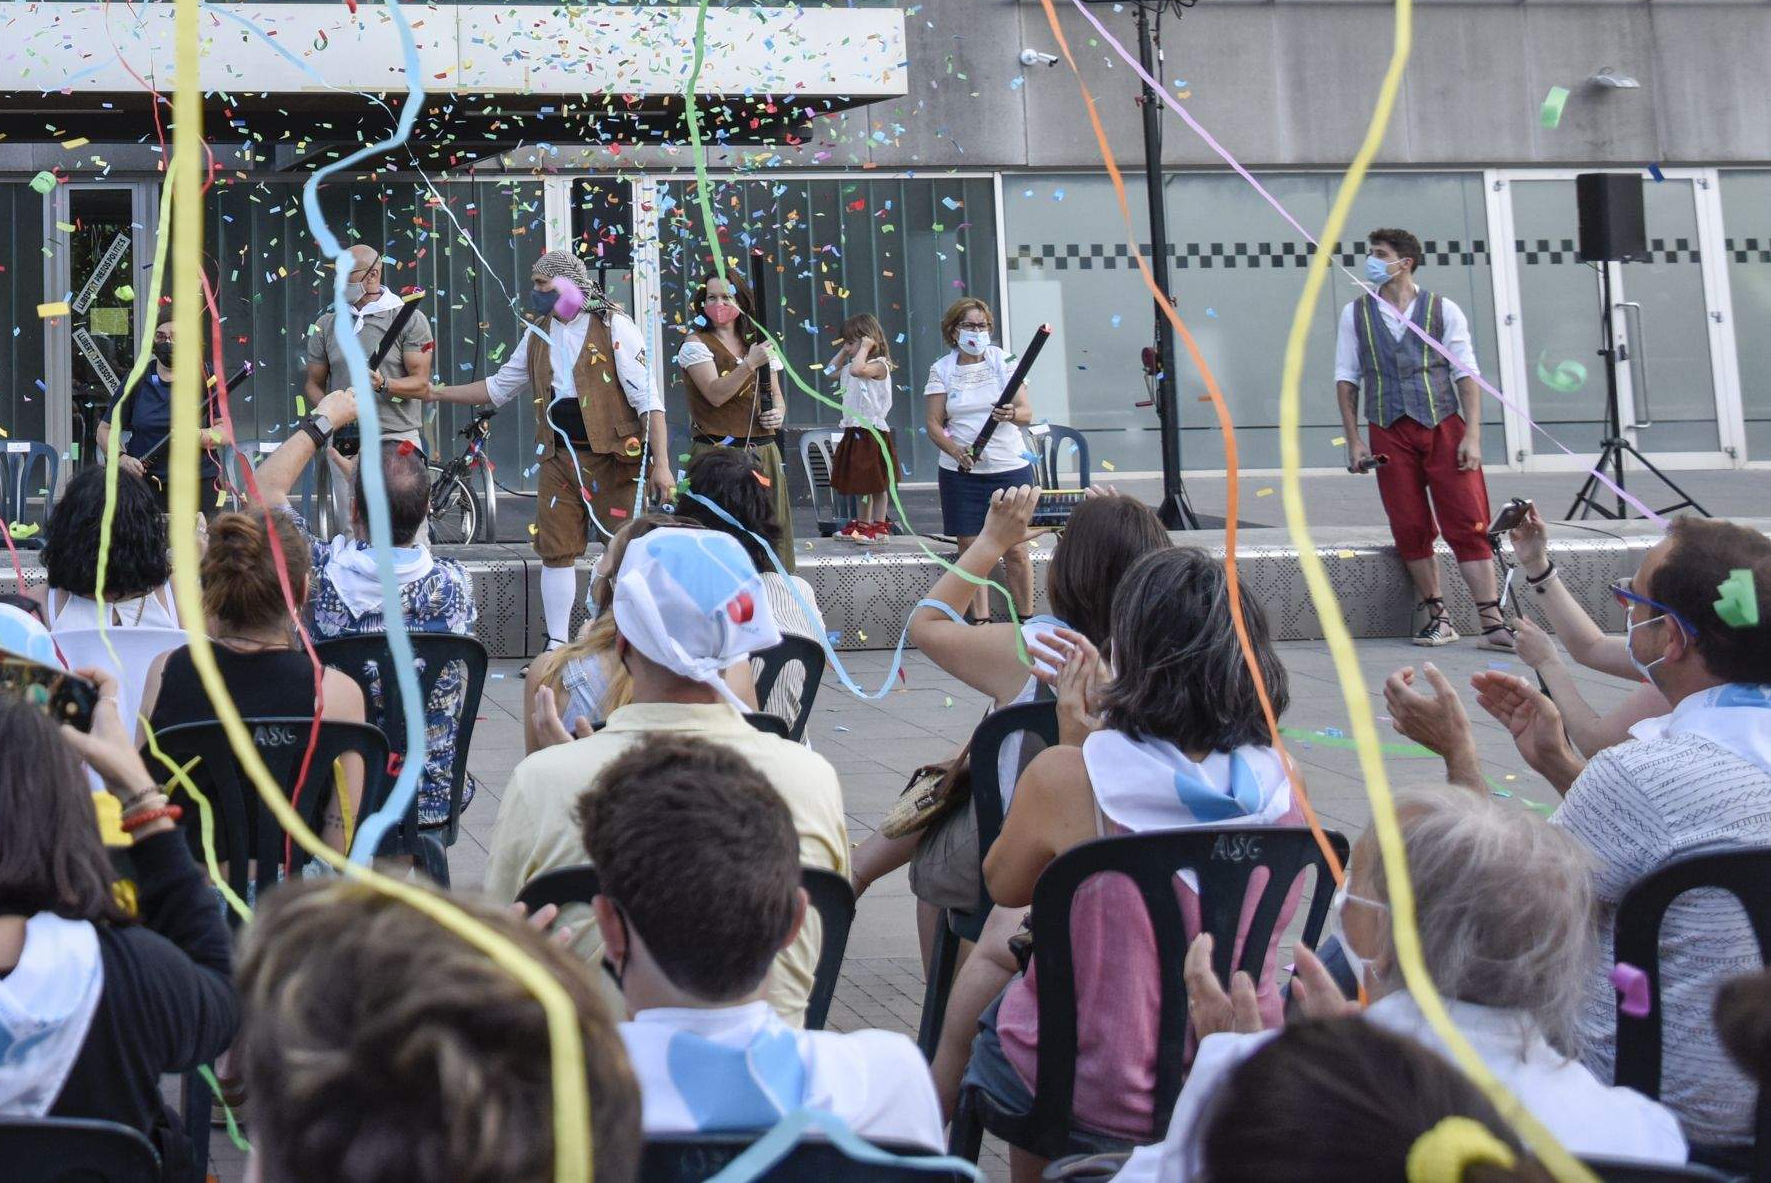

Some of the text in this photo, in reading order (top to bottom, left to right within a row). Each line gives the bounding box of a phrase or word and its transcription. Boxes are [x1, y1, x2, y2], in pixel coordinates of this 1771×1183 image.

[94, 261, 112, 283] PRESOS
[76, 331, 99, 361] LLIBERTT
[94, 358, 112, 381] PRESOS
